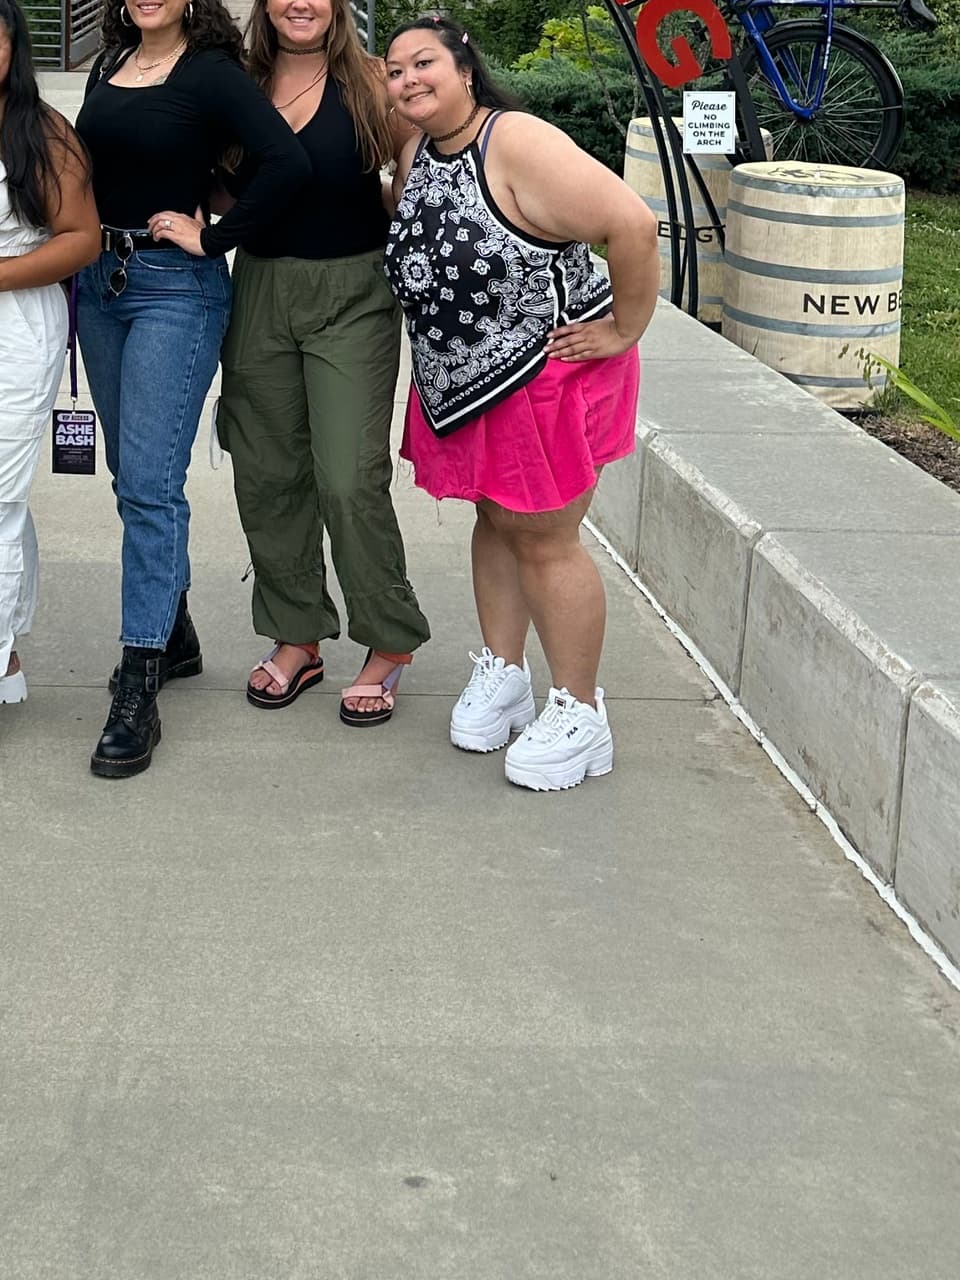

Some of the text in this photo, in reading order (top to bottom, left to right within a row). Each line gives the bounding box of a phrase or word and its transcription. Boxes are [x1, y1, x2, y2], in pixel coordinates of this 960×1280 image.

[691, 100, 727, 110] Please
[803, 293, 880, 315] NEW
[56, 424, 94, 434] ASHE
[56, 435, 94, 445] BASH
